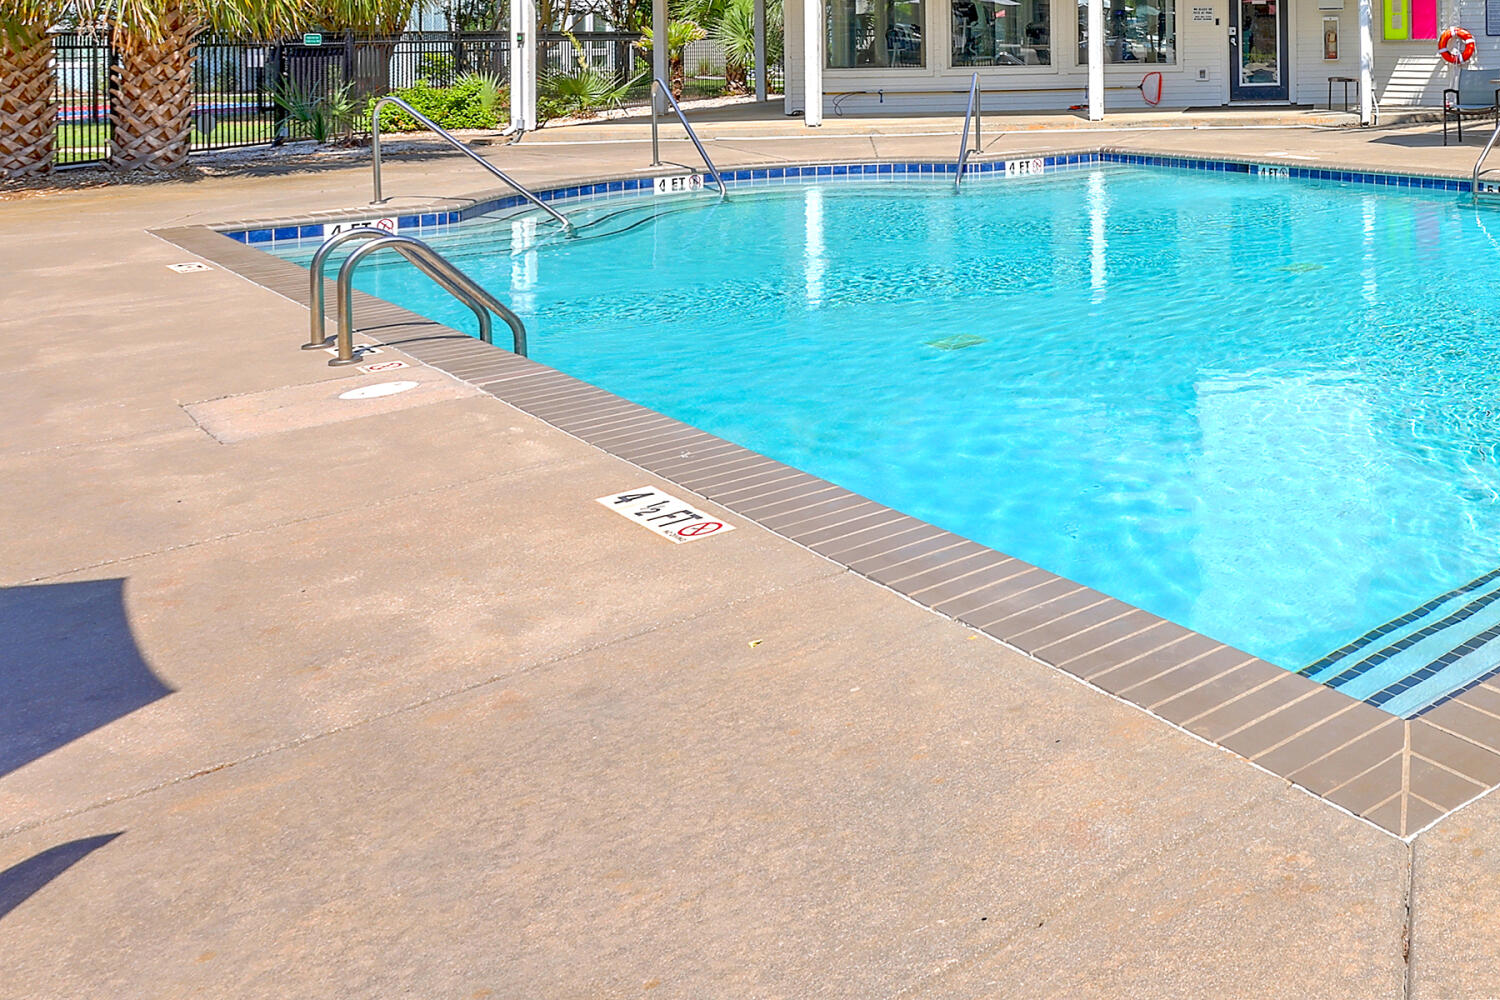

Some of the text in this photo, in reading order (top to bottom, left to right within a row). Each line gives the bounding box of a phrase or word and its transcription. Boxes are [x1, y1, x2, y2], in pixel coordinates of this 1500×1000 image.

[1019, 161, 1030, 173] FT
[613, 492, 655, 505] 4
[646, 509, 703, 528] FT
